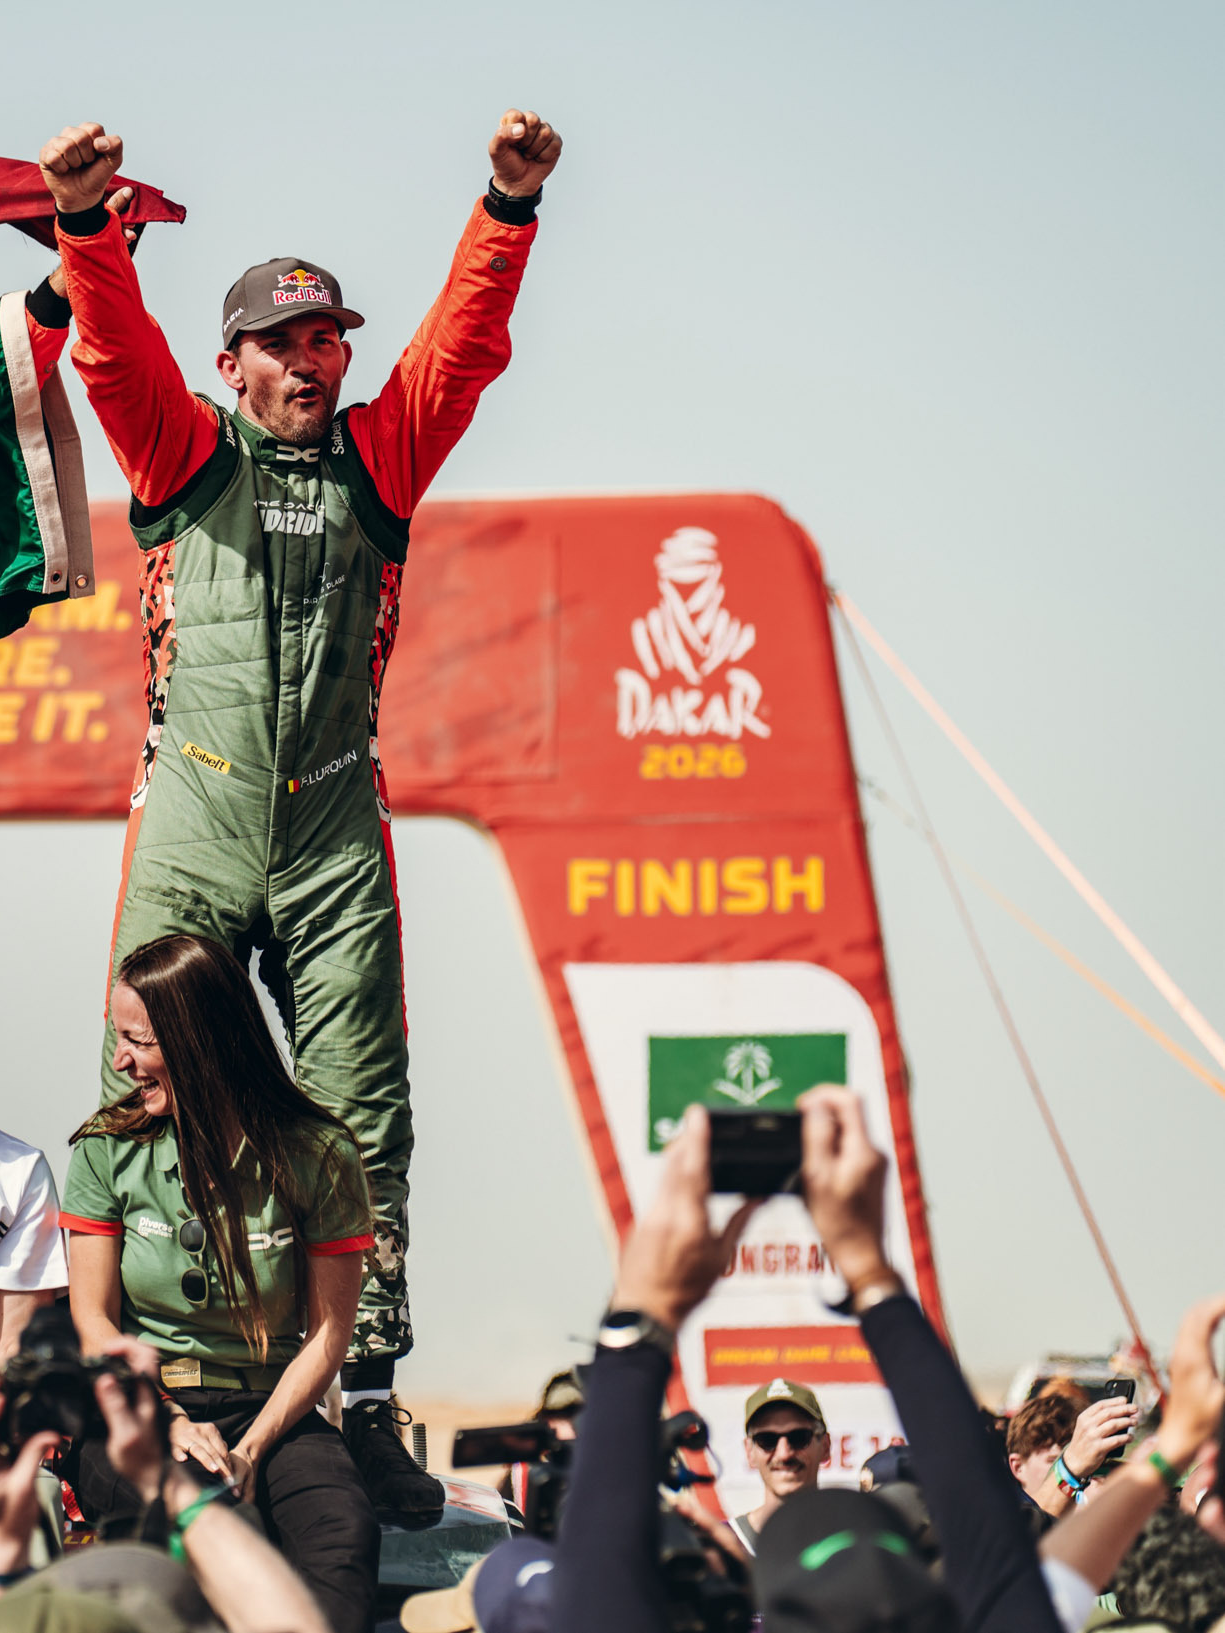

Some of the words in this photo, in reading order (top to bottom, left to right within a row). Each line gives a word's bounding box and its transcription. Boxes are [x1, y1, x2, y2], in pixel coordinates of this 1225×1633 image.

[273, 287, 305, 305] Red
[305, 287, 333, 305] Bull
[30, 690, 110, 745] IT.
[613, 667, 772, 740] DAKAR
[187, 745, 227, 772] Sabelt
[639, 742, 748, 780] 2026
[565, 855, 825, 917] FINISH
